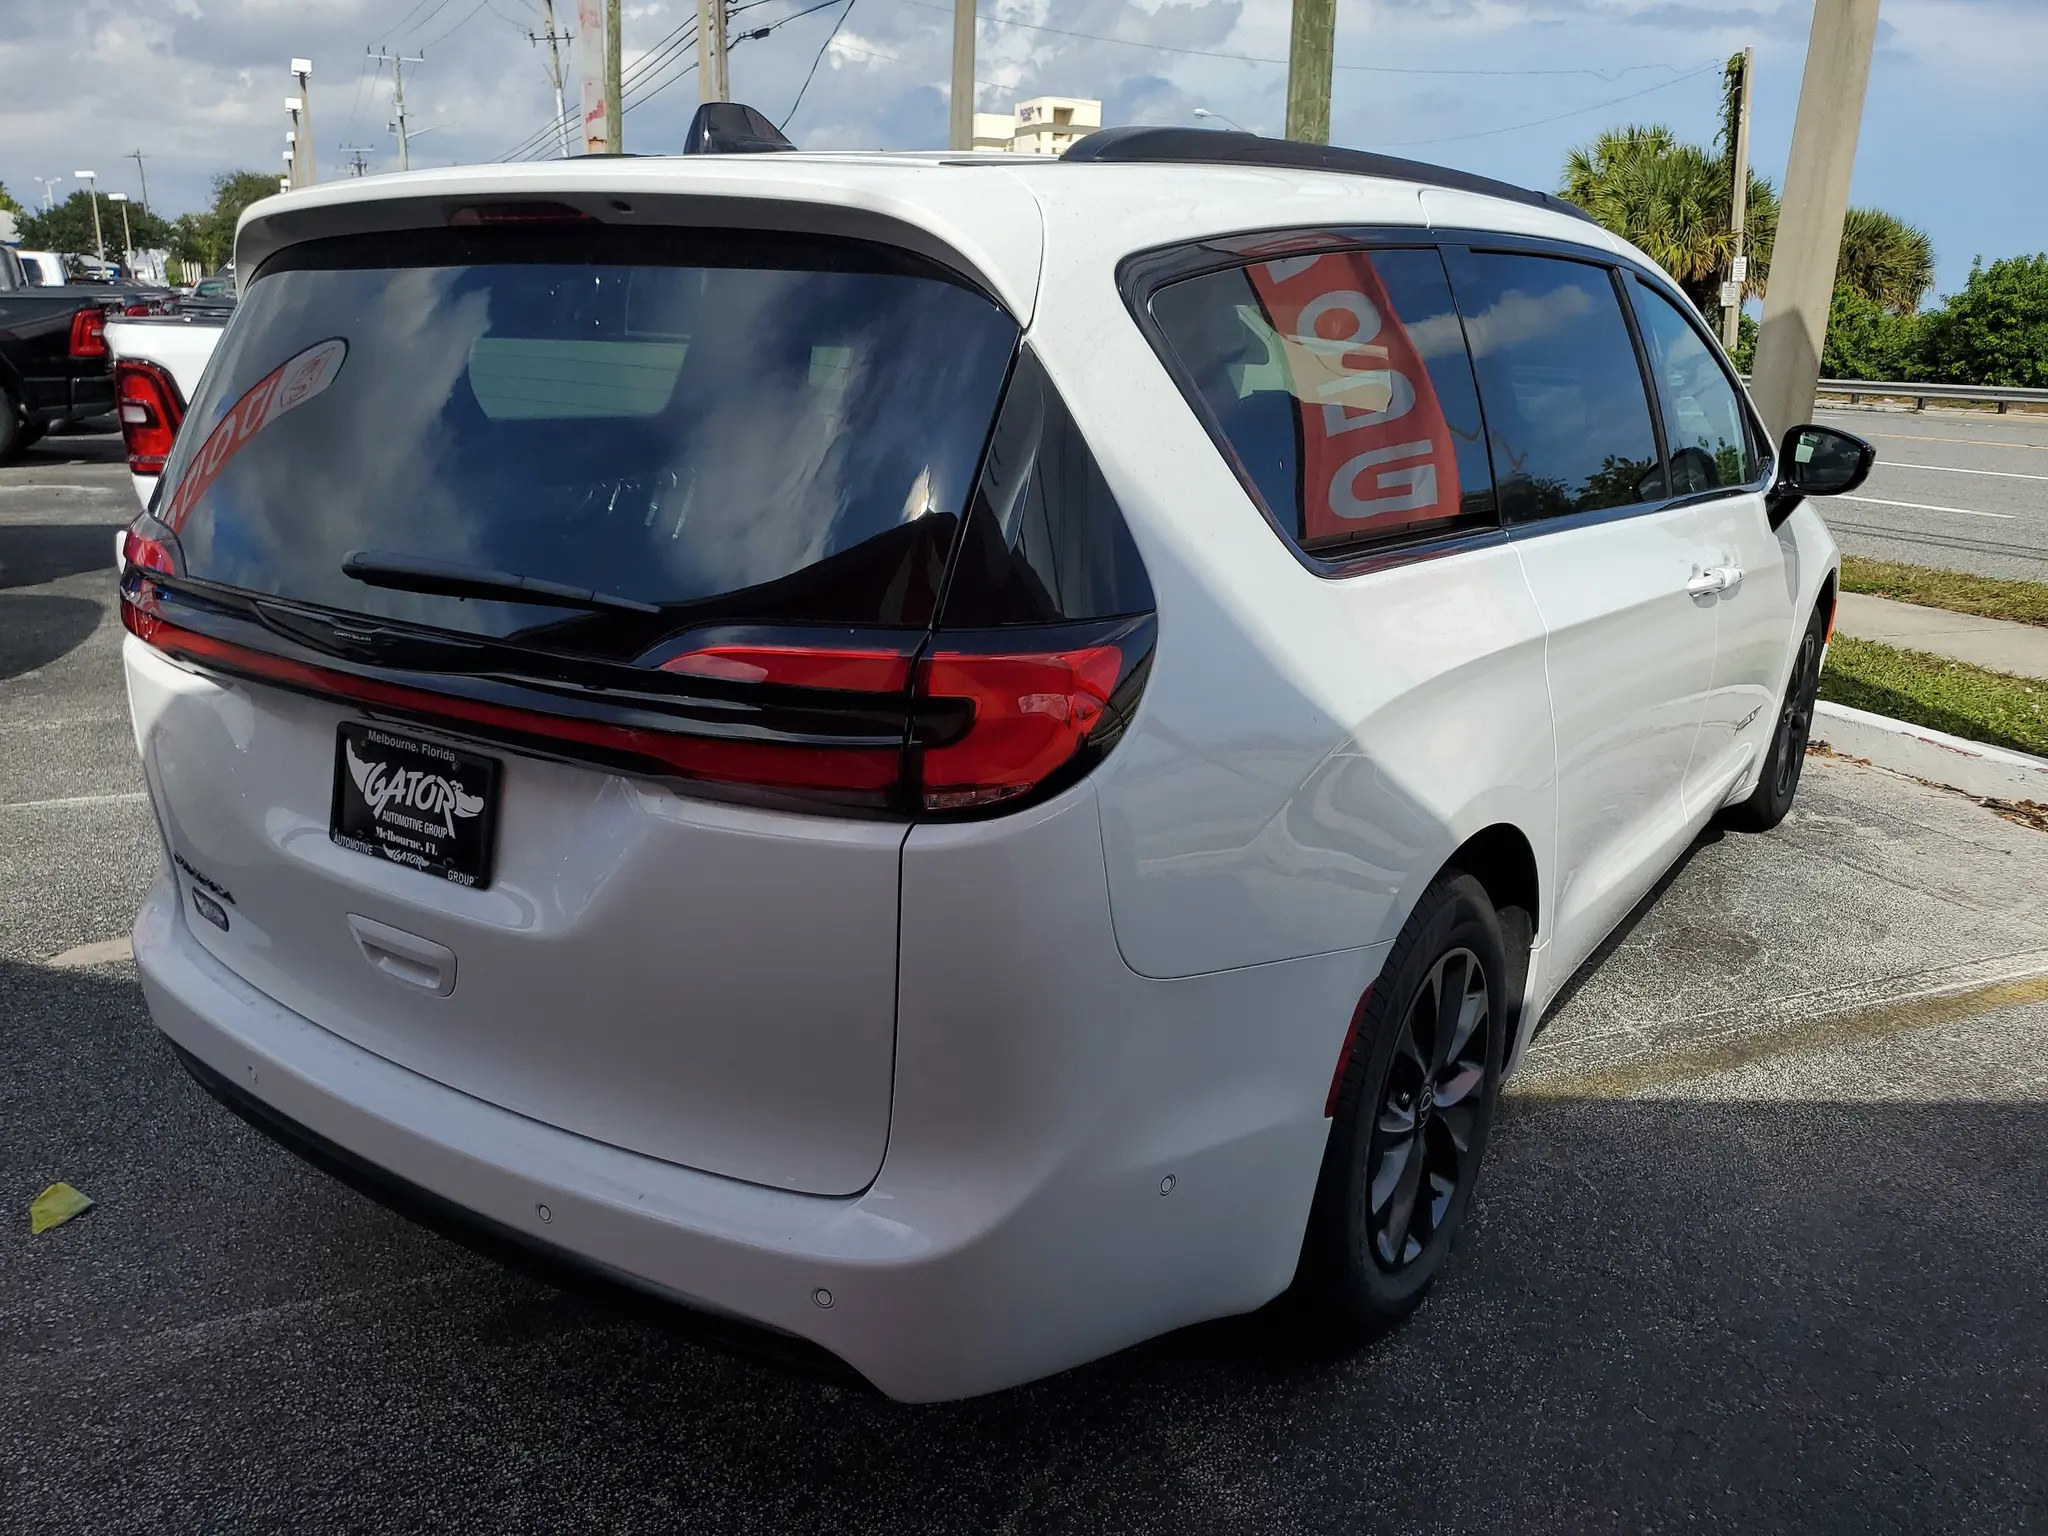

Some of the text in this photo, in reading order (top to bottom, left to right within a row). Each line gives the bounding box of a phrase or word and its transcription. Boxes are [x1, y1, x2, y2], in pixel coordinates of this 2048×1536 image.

[368, 730, 455, 761] Melbourne, Florida
[364, 762, 456, 839] GATOR
[382, 810, 447, 838] AUTOMOTIVE GROUP
[334, 833, 373, 855] AUTOMOTIVE
[448, 870, 474, 886] GROUP
